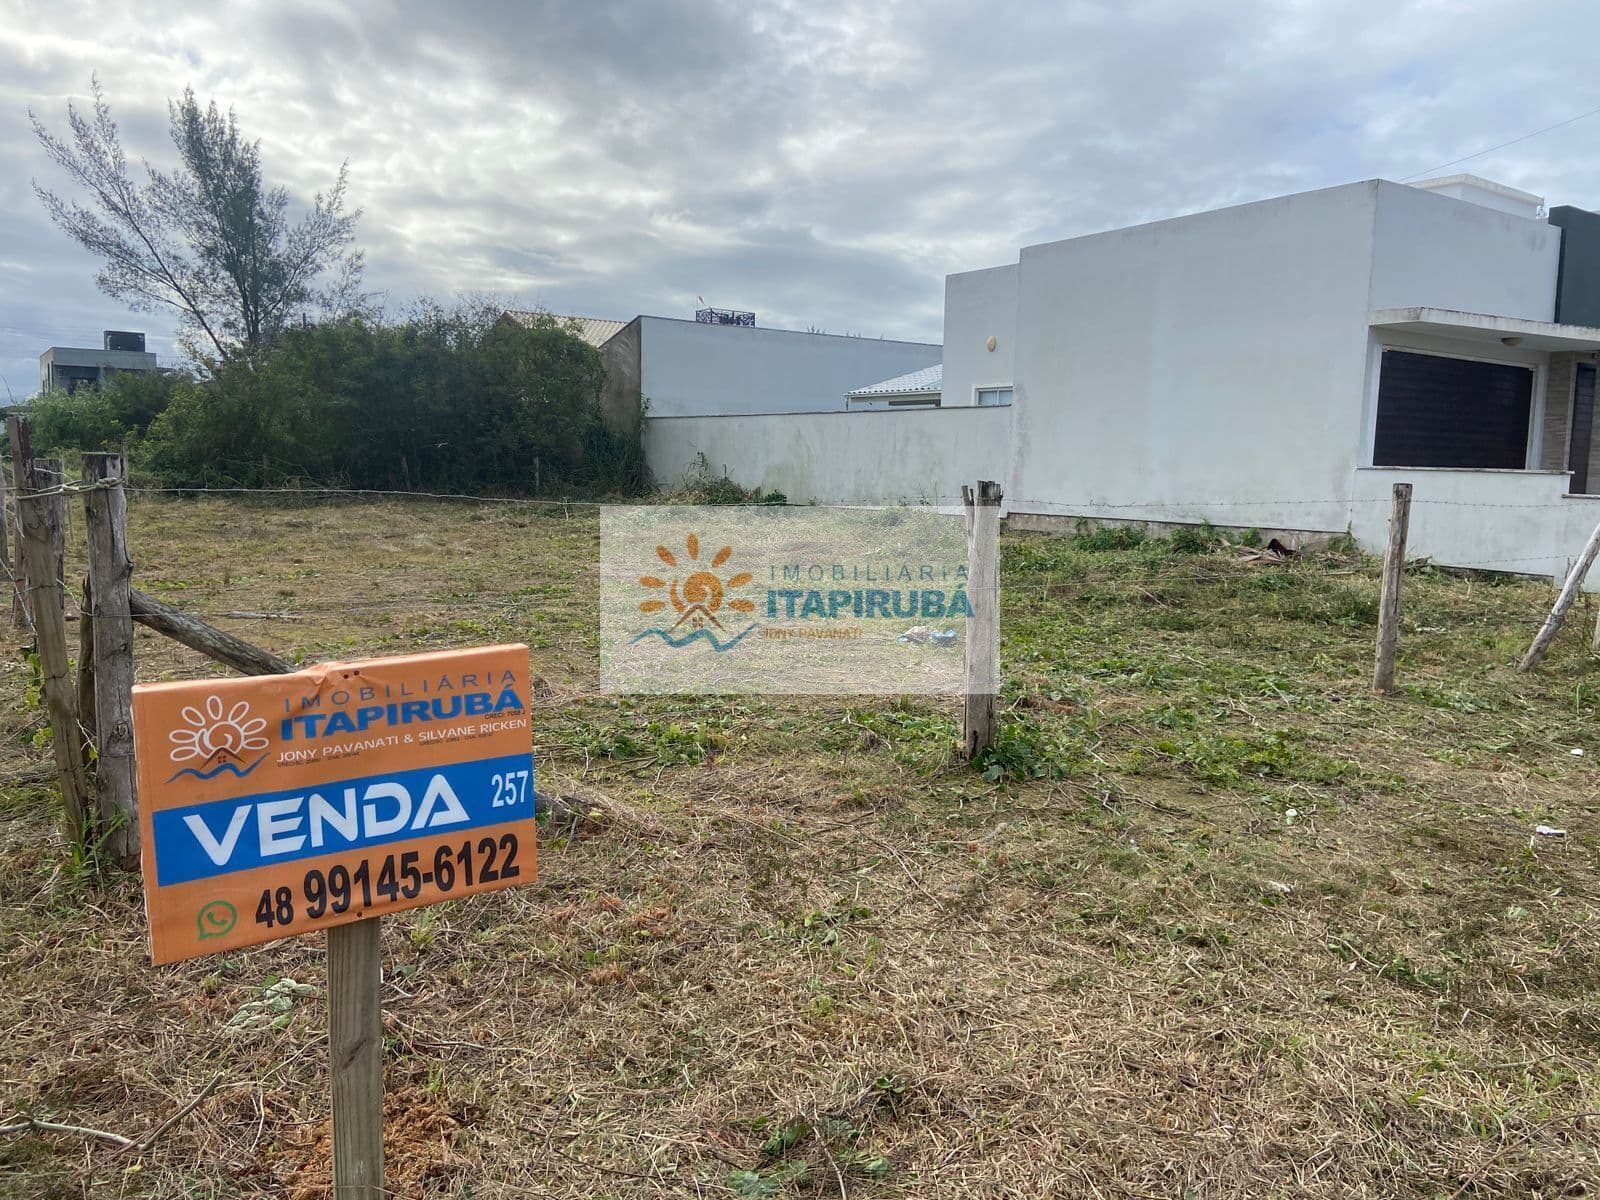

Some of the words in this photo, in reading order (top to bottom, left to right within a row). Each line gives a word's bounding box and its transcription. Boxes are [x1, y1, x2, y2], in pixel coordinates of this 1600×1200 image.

[280, 683, 525, 742] ITAPIRUBÁ
[285, 669, 517, 713] IMOBILIÁRIA
[276, 748, 318, 763] JONY
[322, 735, 400, 756] PAVANATI
[403, 734, 414, 743] &
[418, 726, 477, 743] SILVANE
[480, 718, 528, 735] RICKEN
[491, 769, 529, 808] 257
[182, 773, 472, 867] VENDA
[255, 886, 293, 928] 48
[303, 832, 521, 919] 99145-6122
